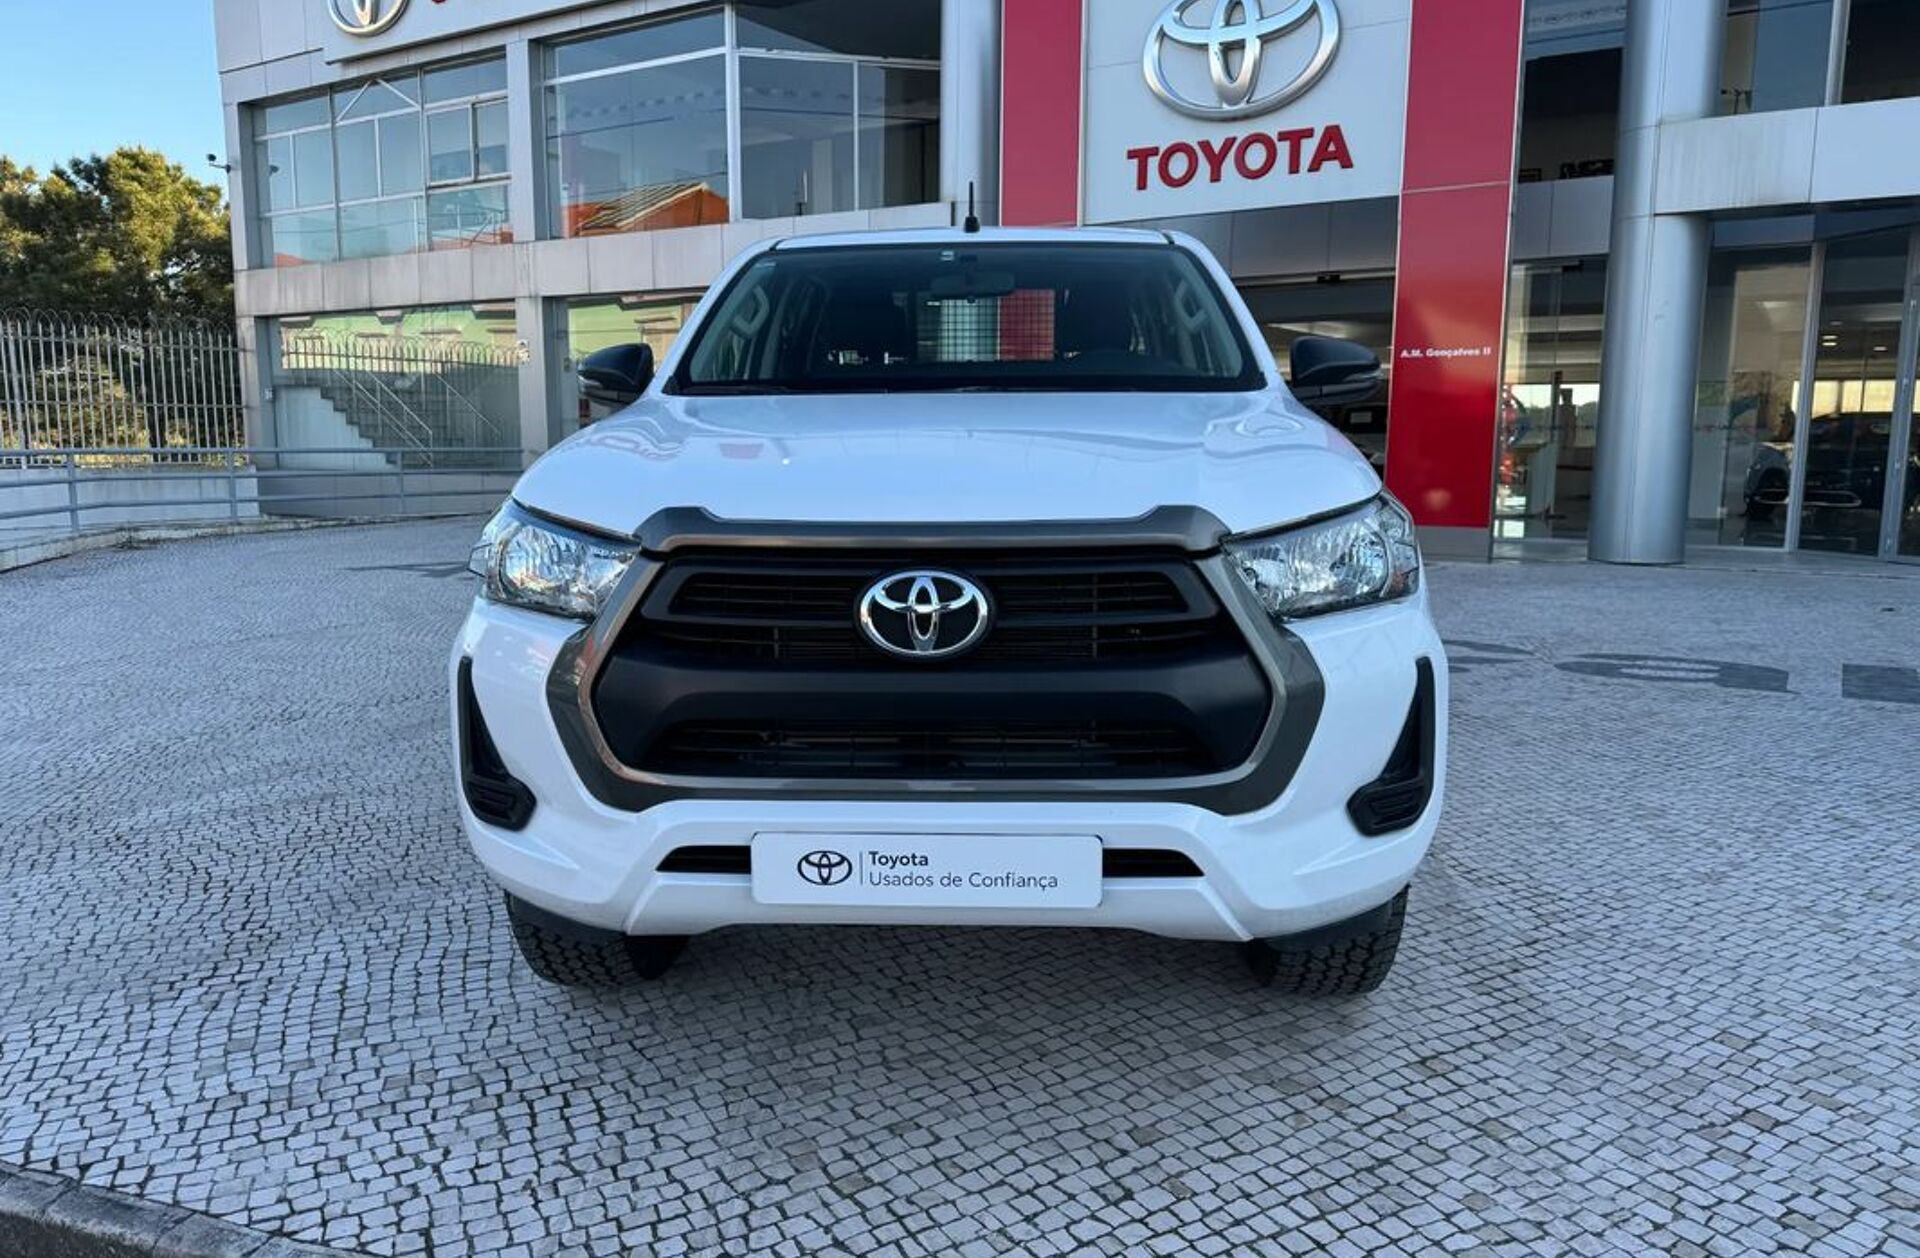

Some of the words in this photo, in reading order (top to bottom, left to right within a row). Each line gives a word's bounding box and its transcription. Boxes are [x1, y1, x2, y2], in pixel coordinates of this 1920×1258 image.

[1127, 125, 1353, 190] TOYOTA
[1401, 349, 1423, 358] A.M.
[1426, 347, 1480, 359] Gonçalves
[869, 851, 929, 869] Toyota
[869, 872, 934, 887] Usados
[940, 872, 963, 887] de
[968, 872, 1059, 891] Confiança
